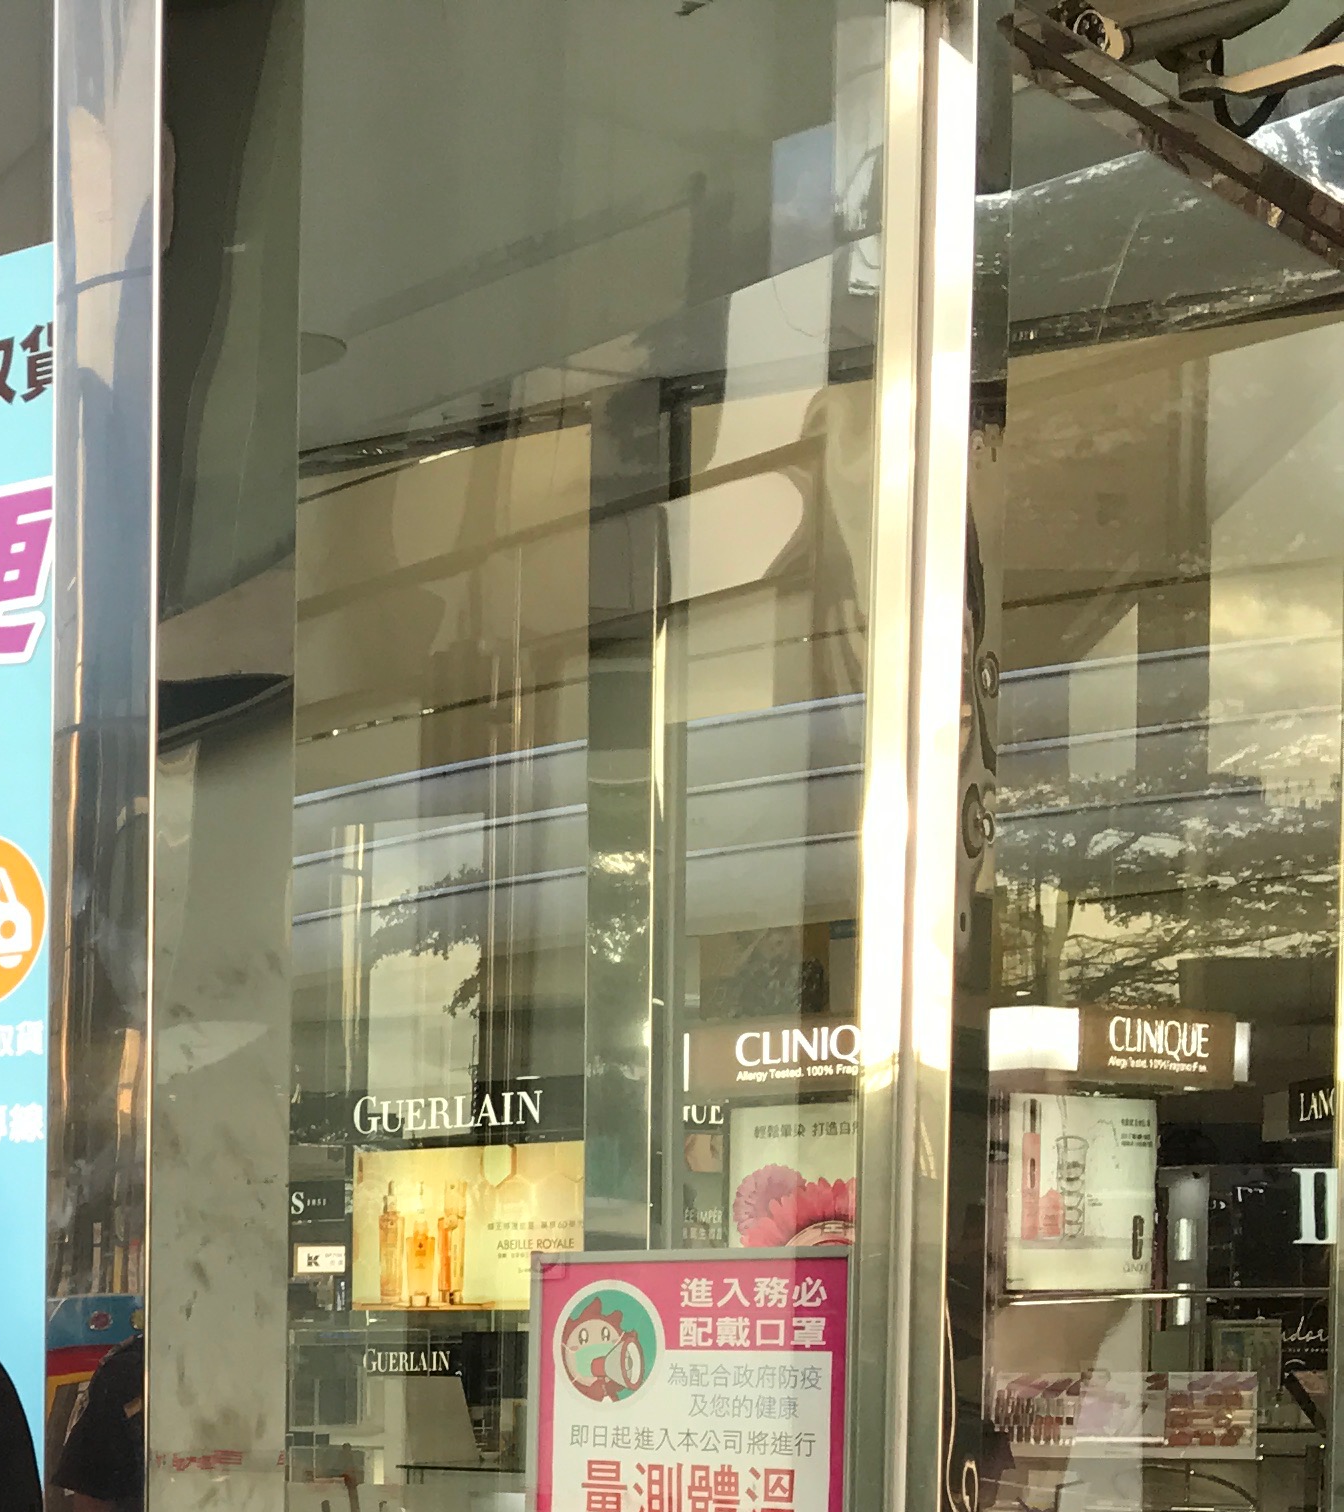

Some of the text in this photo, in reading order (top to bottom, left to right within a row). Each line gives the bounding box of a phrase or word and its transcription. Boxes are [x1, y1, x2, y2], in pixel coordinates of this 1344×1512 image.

[1109, 1016, 1210, 1061] CLINIQUE
[806, 1064, 833, 1077] 100%
[353, 1089, 543, 1134] GUERLAIN
[497, 1238, 575, 1250] ABEILLE ROYALE
[680, 1277, 827, 1308] 進入務必
[678, 1316, 827, 1348] 配戴口罩
[363, 1347, 450, 1374] GUERLAIN
[667, 1363, 823, 1391] 為配合政府防疫
[687, 1393, 800, 1420] 及您的健康
[569, 1424, 816, 1458] 即日起進入本公司將進行
